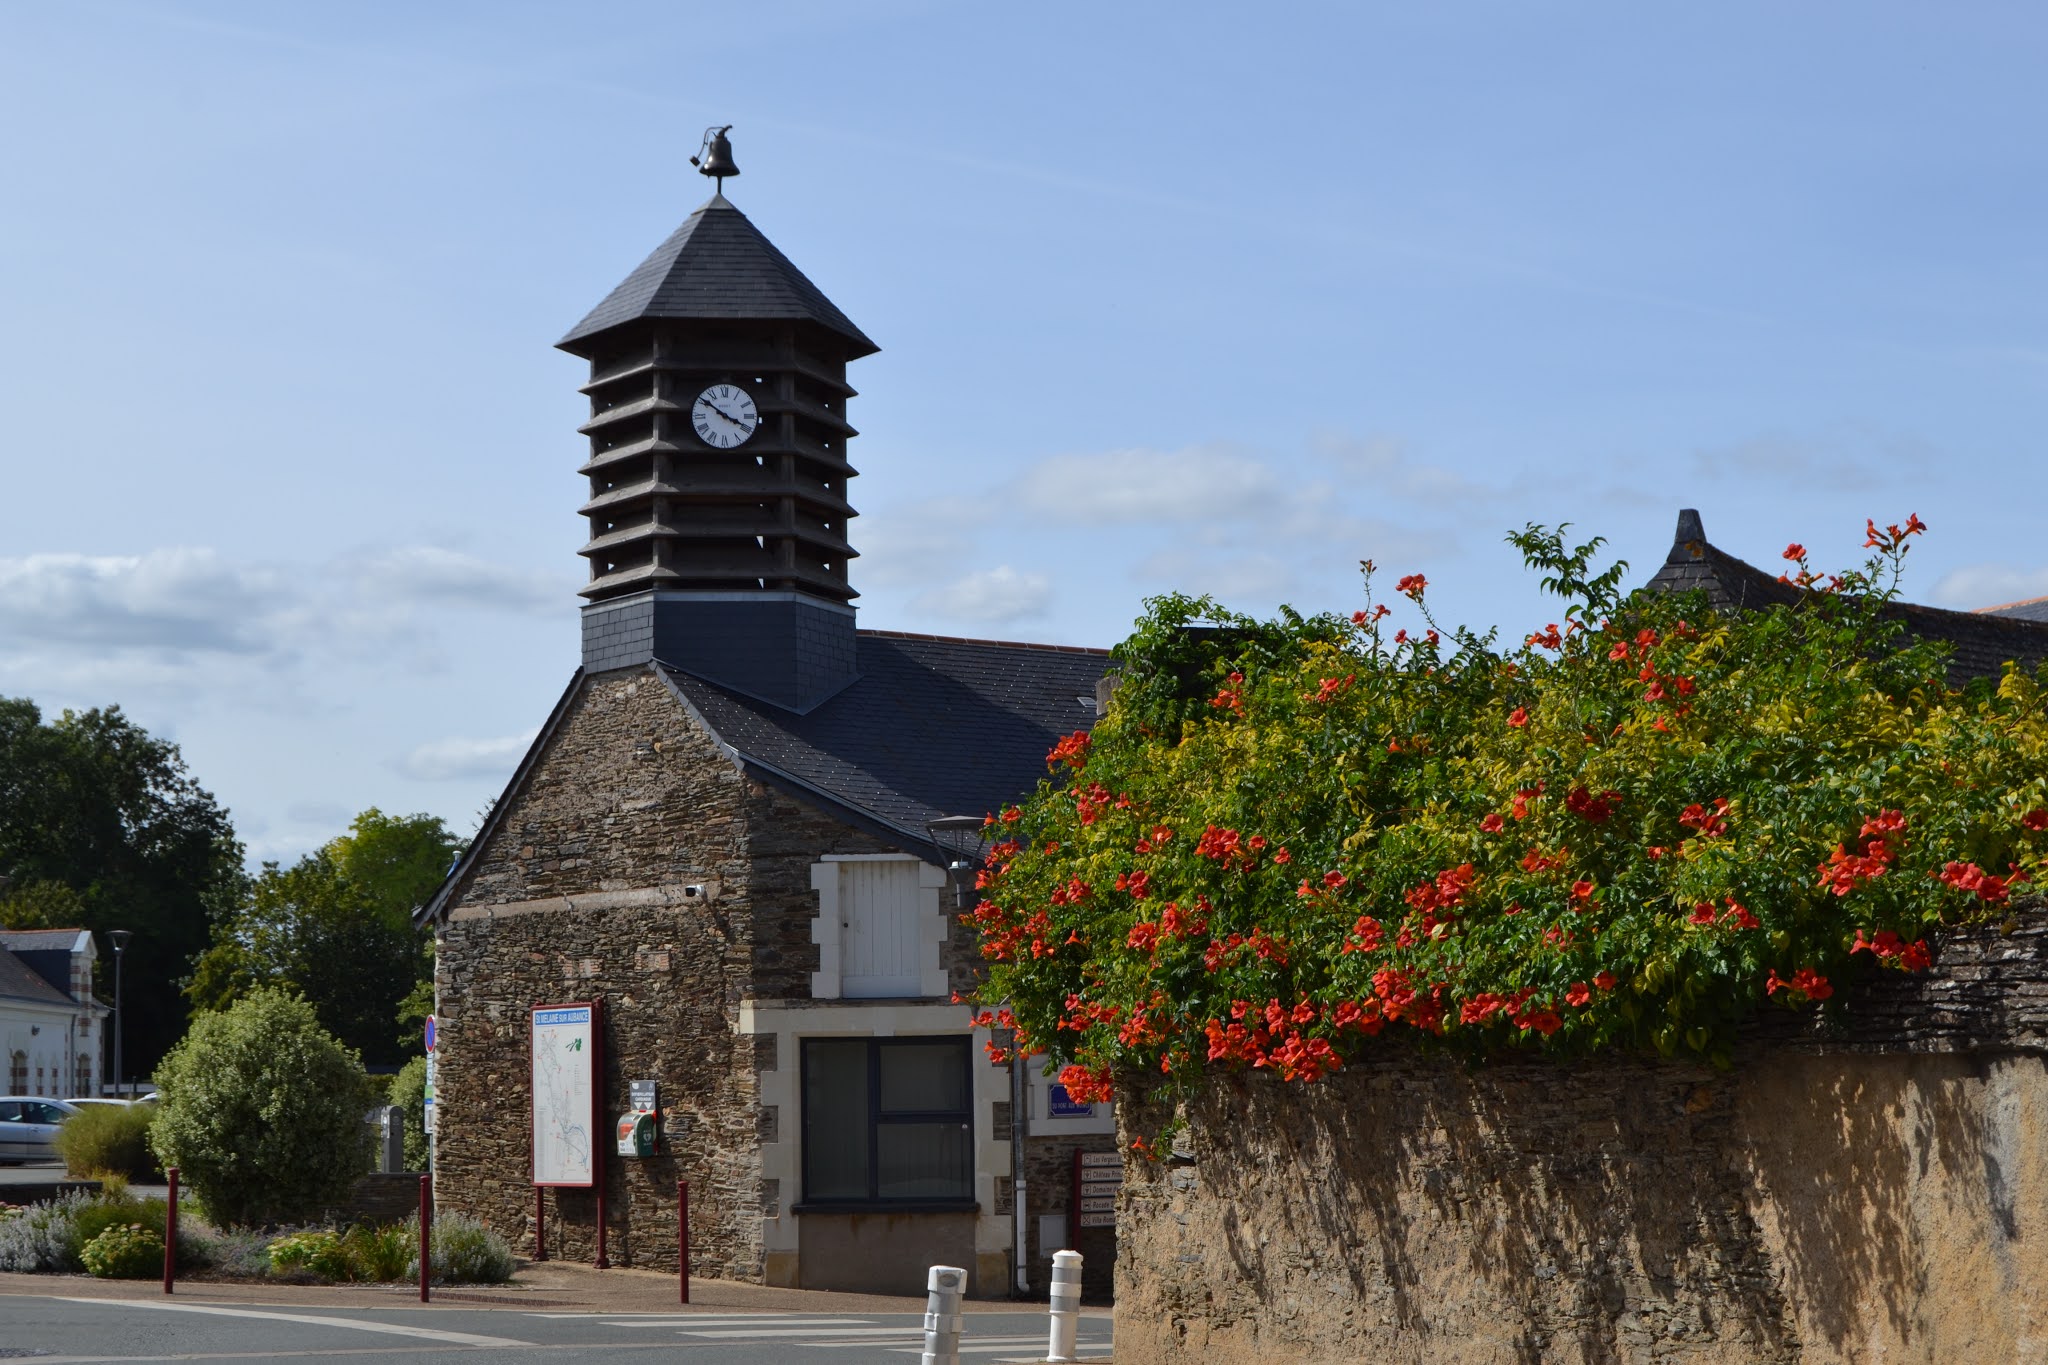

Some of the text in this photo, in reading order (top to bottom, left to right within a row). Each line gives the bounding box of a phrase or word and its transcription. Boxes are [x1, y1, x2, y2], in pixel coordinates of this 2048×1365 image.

[568, 1011, 588, 1022] AUBANCE
[1101, 1155, 1117, 1165] Vergers
[1093, 1185, 1112, 1193] Domaine
[1093, 1201, 1110, 1209] Rocade
